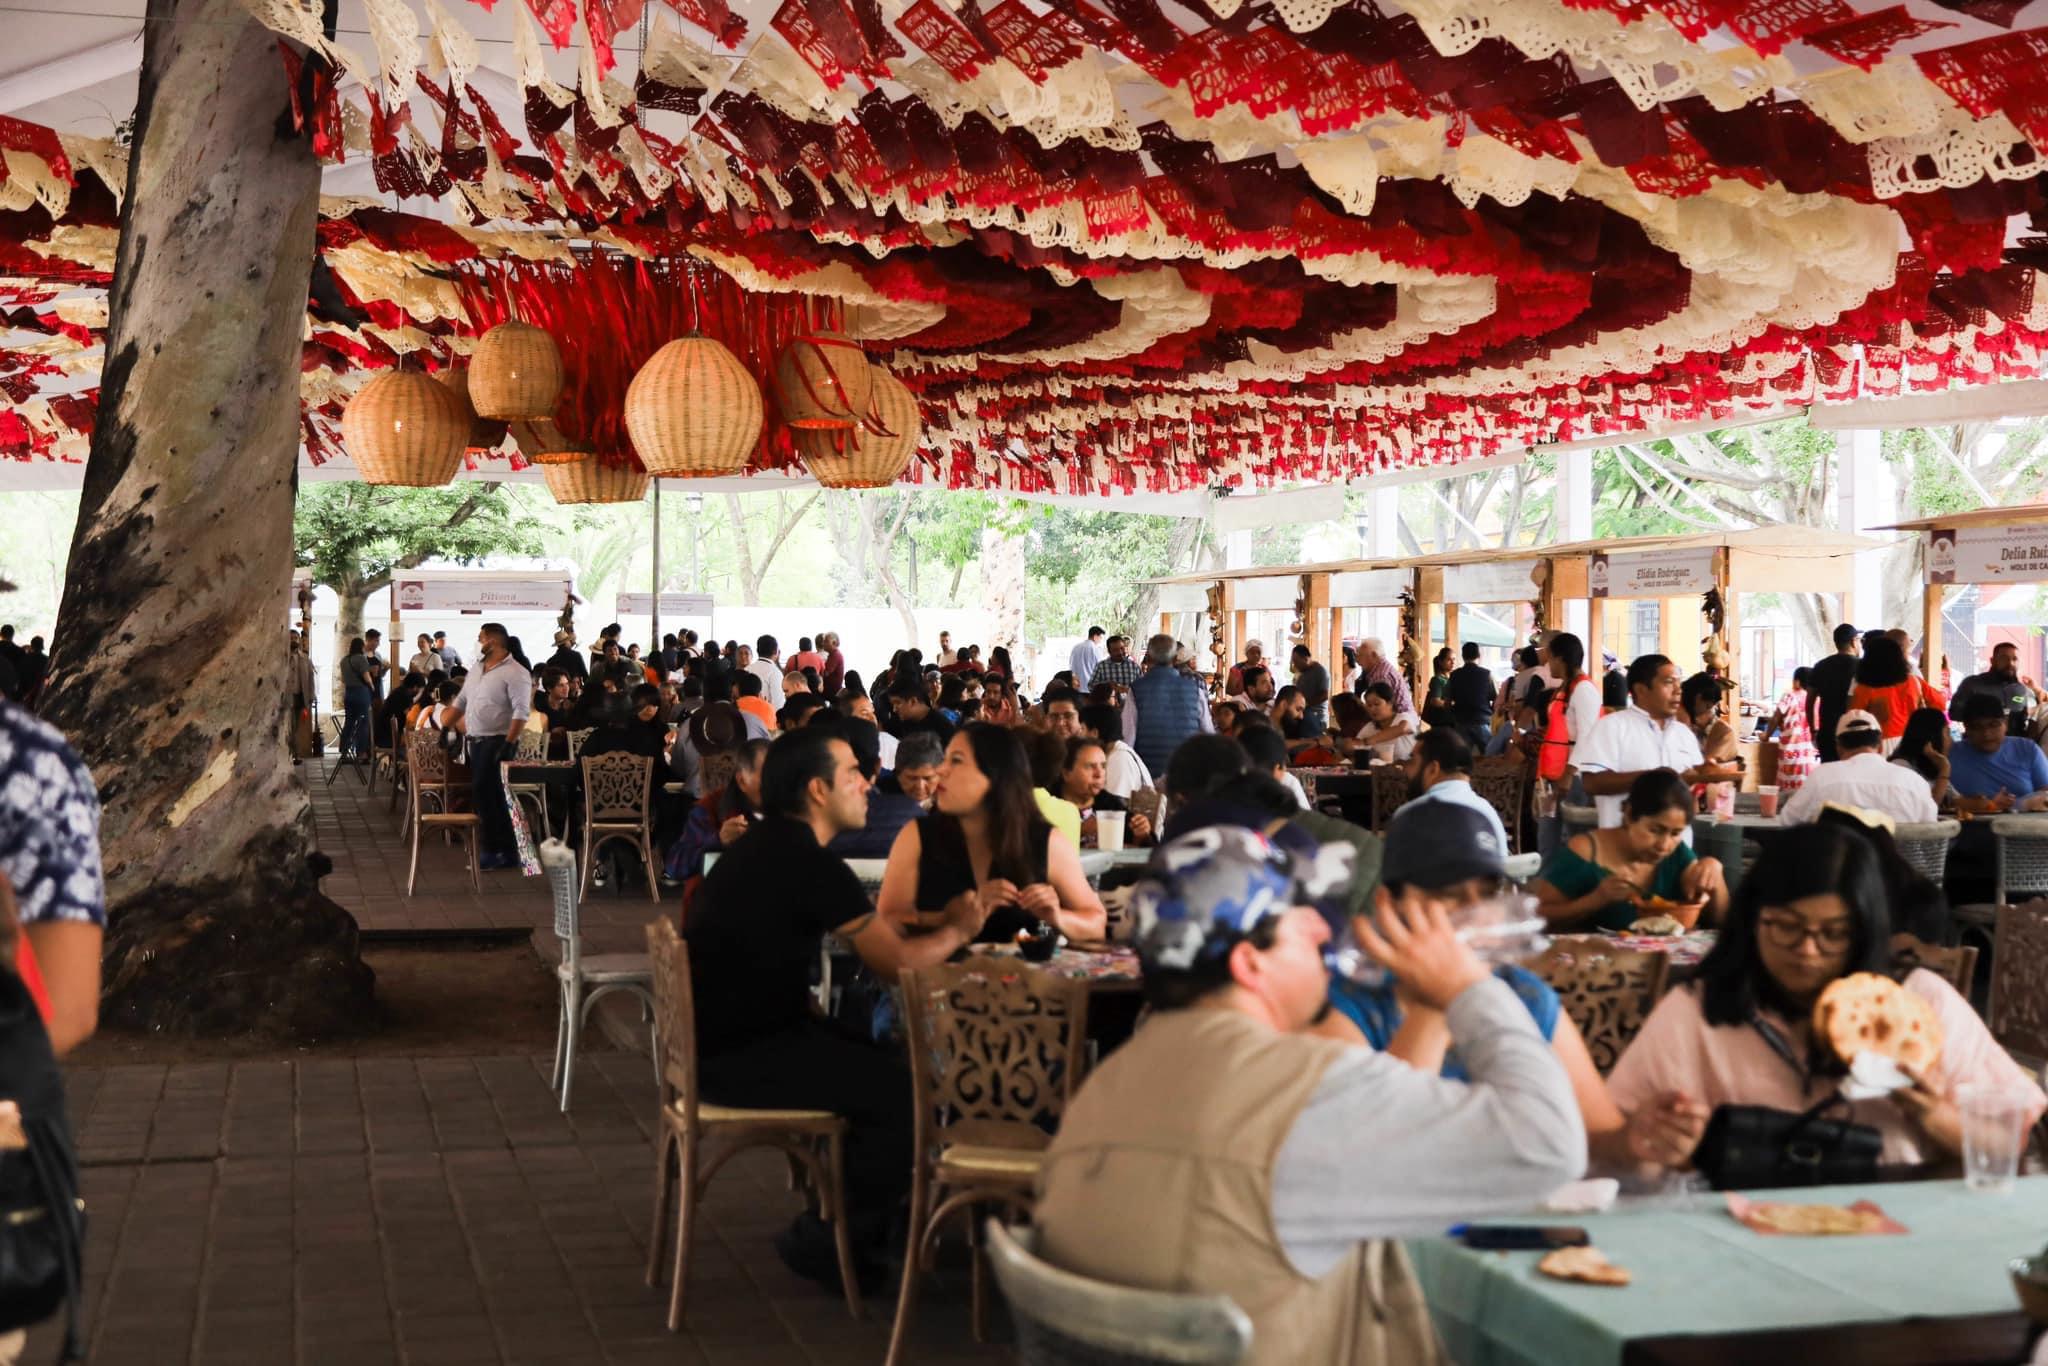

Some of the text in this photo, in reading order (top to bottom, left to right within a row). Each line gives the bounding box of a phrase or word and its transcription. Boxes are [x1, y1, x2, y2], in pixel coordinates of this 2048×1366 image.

[2001, 543, 2048, 561] Delia Rui
[2010, 563, 2028, 571] MOLE
[2029, 562, 2038, 570] DE
